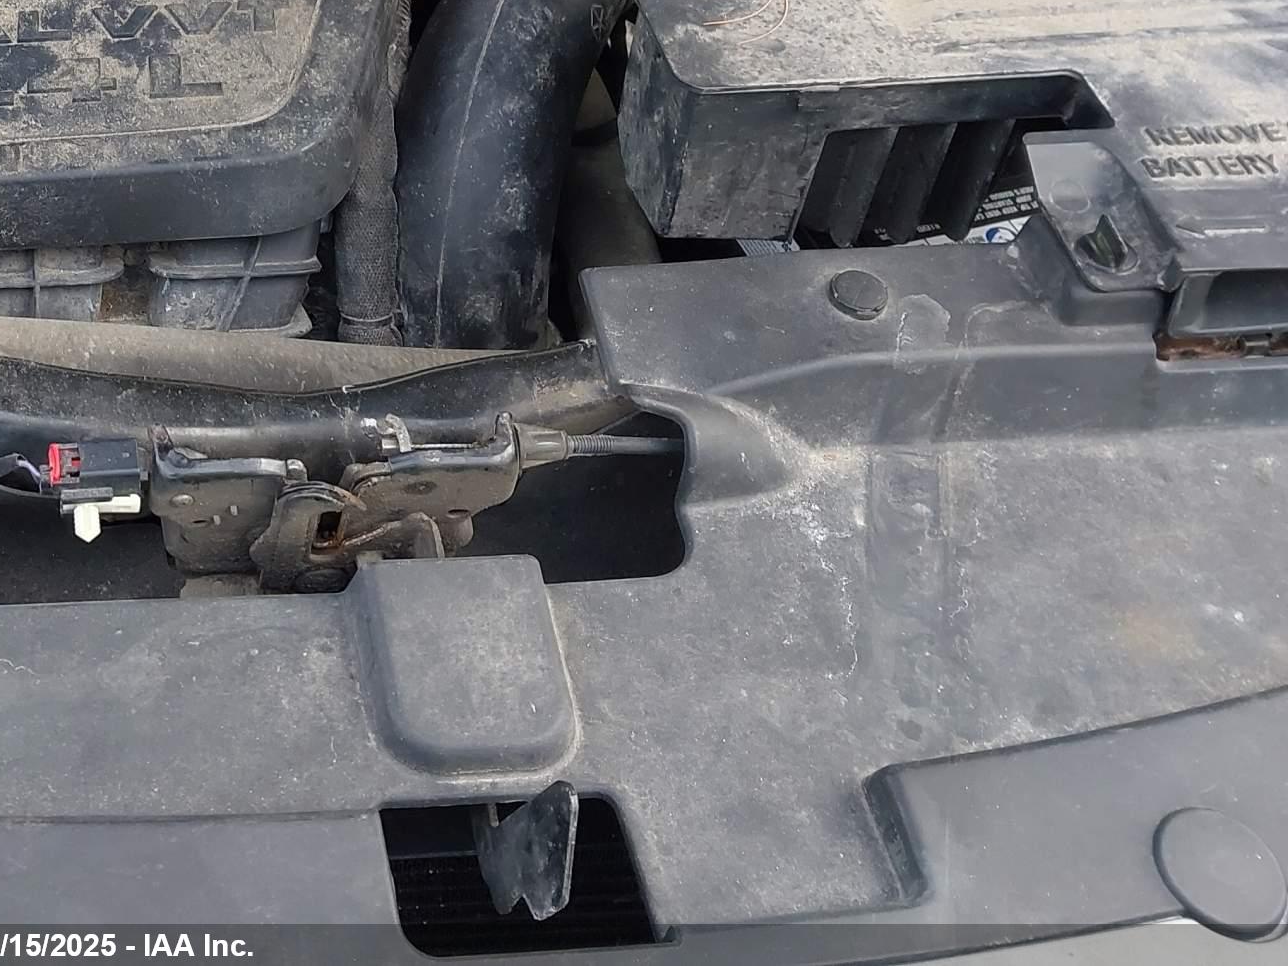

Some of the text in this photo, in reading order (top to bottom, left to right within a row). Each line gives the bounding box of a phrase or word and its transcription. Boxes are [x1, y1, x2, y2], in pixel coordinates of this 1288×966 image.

[91, 0, 289, 40] VVT
[1143, 122, 1287, 147] REMOVE
[1139, 153, 1279, 178] BATTERY
